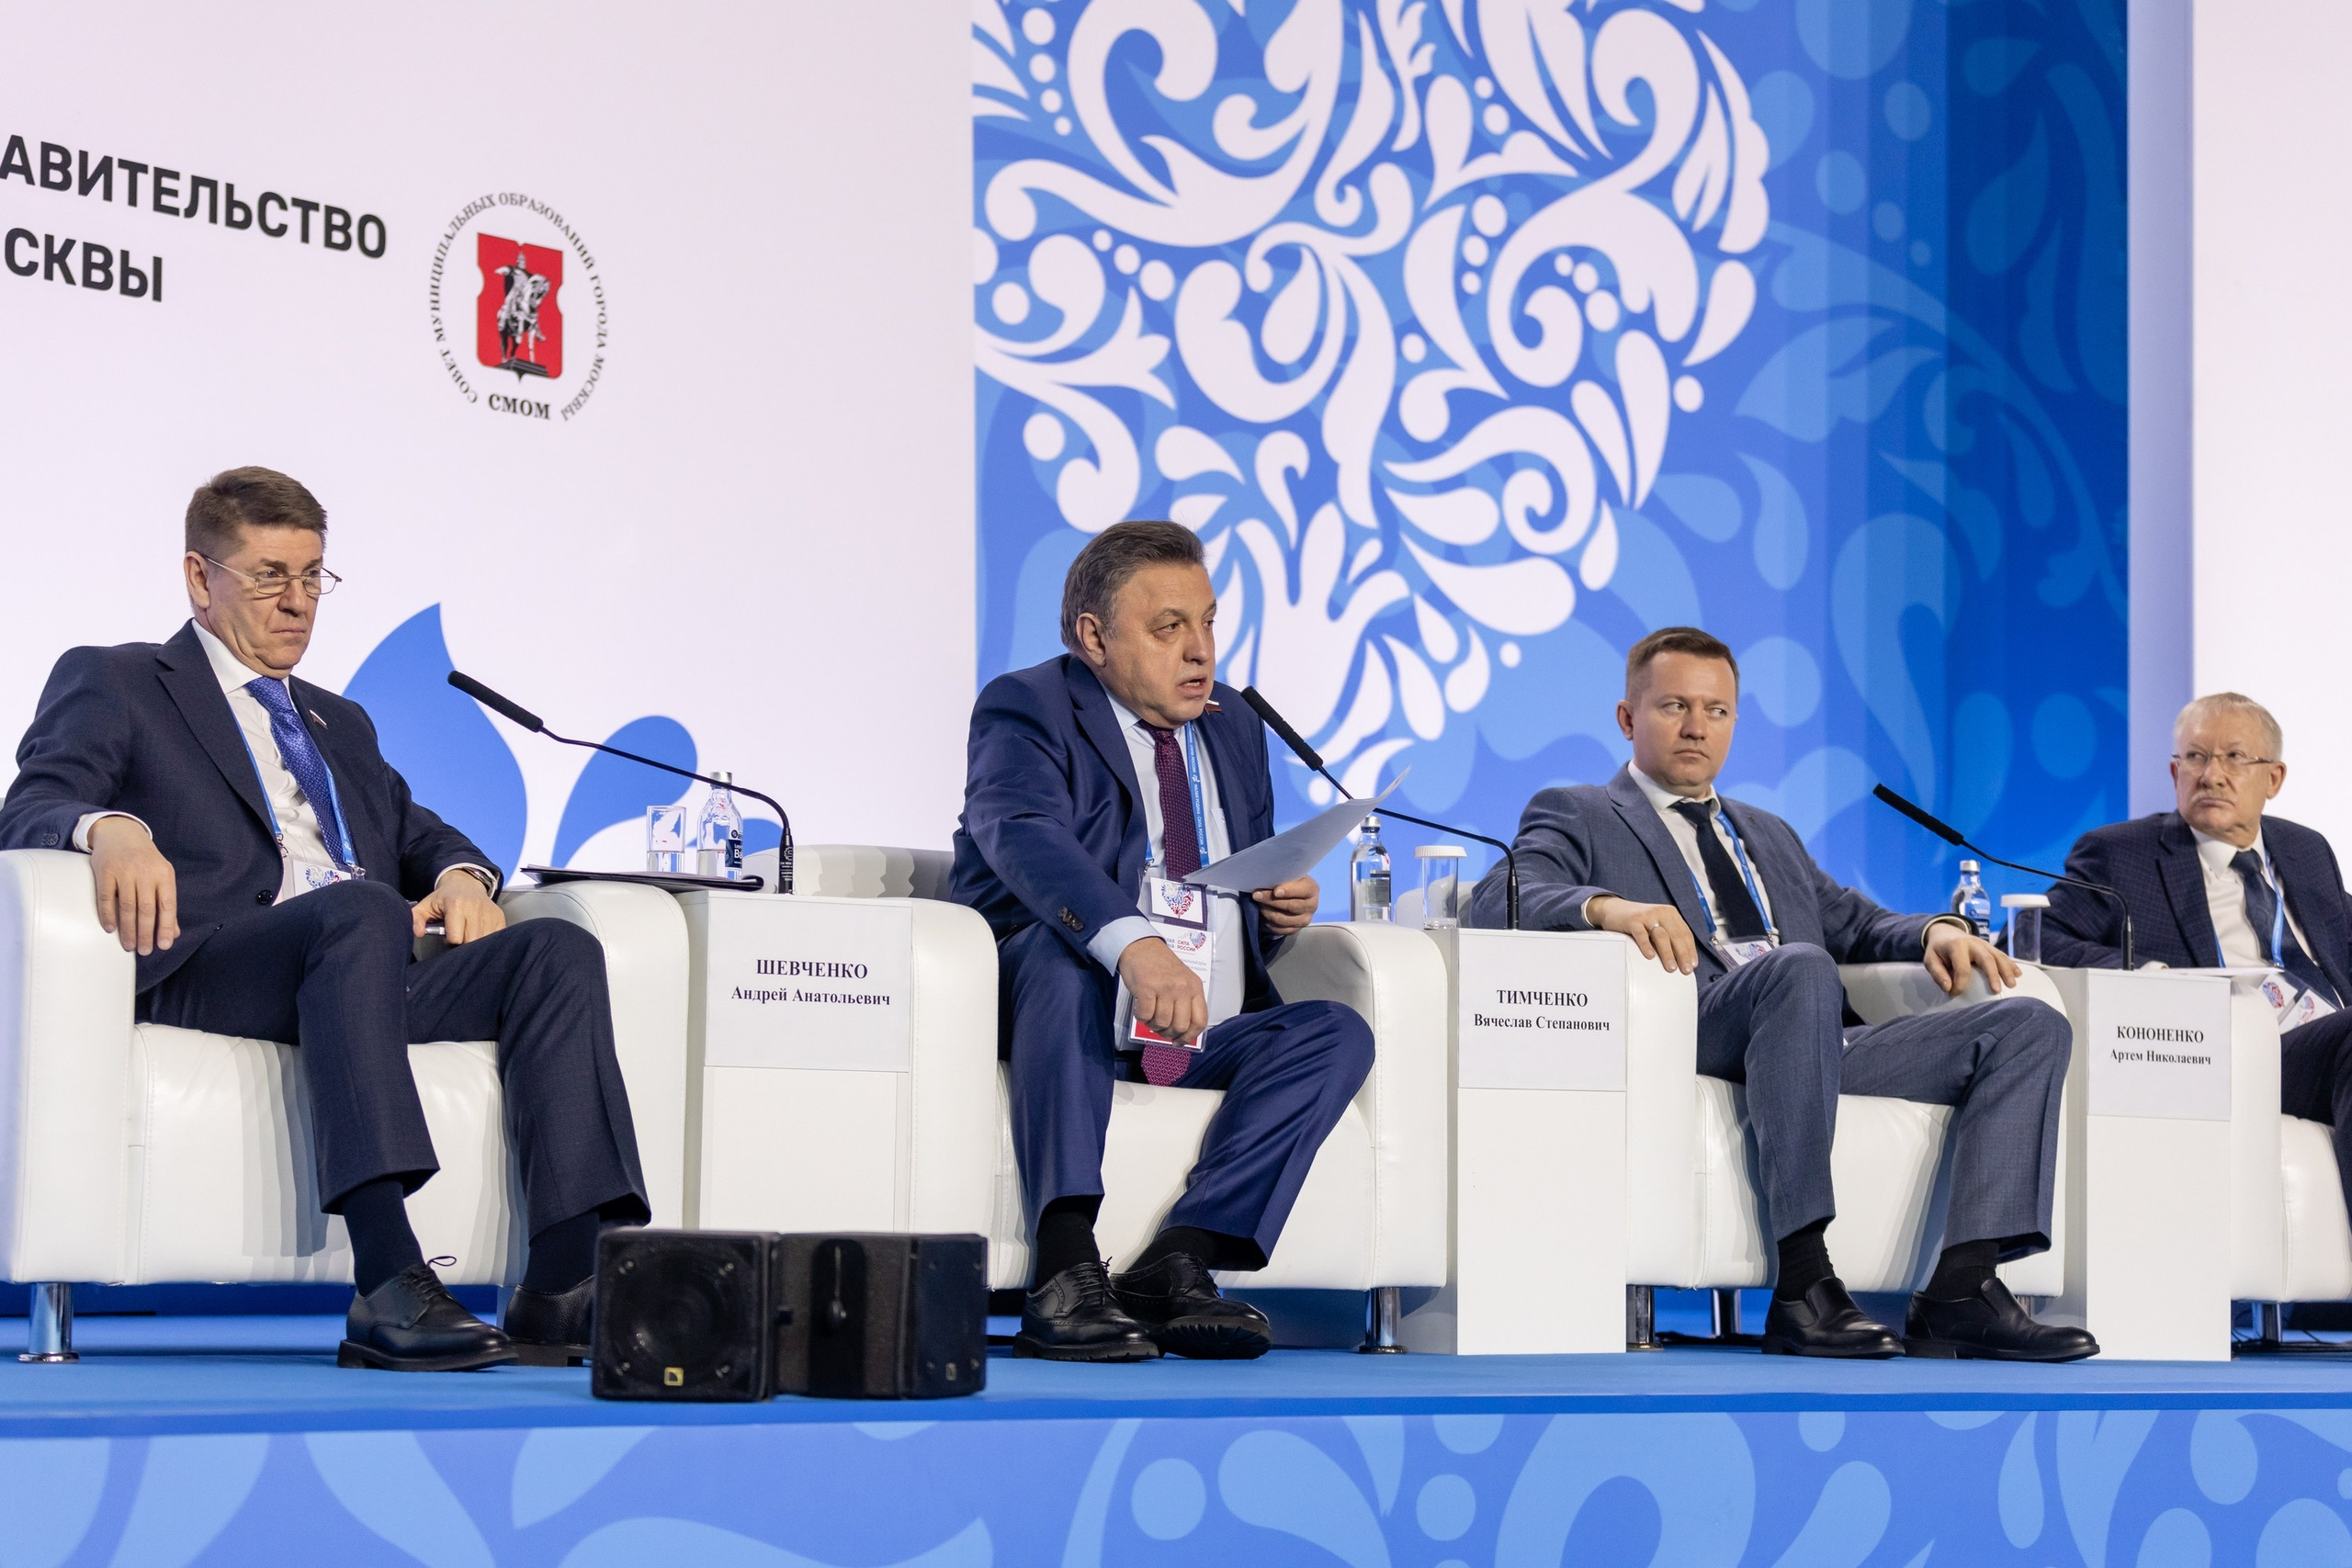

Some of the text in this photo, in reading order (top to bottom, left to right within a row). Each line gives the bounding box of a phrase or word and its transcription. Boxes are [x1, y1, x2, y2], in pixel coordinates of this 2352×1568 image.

[429, 191, 608, 422] СОВЕТ МУНИЦИПАЛЬНЫХ ОБРАЗОВАНИЙ ГОРОДА МОСКВЫ
[488, 392, 551, 421] СМОМ
[756, 959, 868, 979] ШЕВЧЕНКО
[731, 986, 890, 1006] Андрей Анатольевич
[1496, 989, 1589, 1008] ТИМЧЕНКО
[1474, 1013, 1610, 1031] Вячеслав Степанович
[2117, 1025, 2204, 1043] КОНОНЕНКО
[2110, 1048, 2211, 1066] Артем Николаевич
